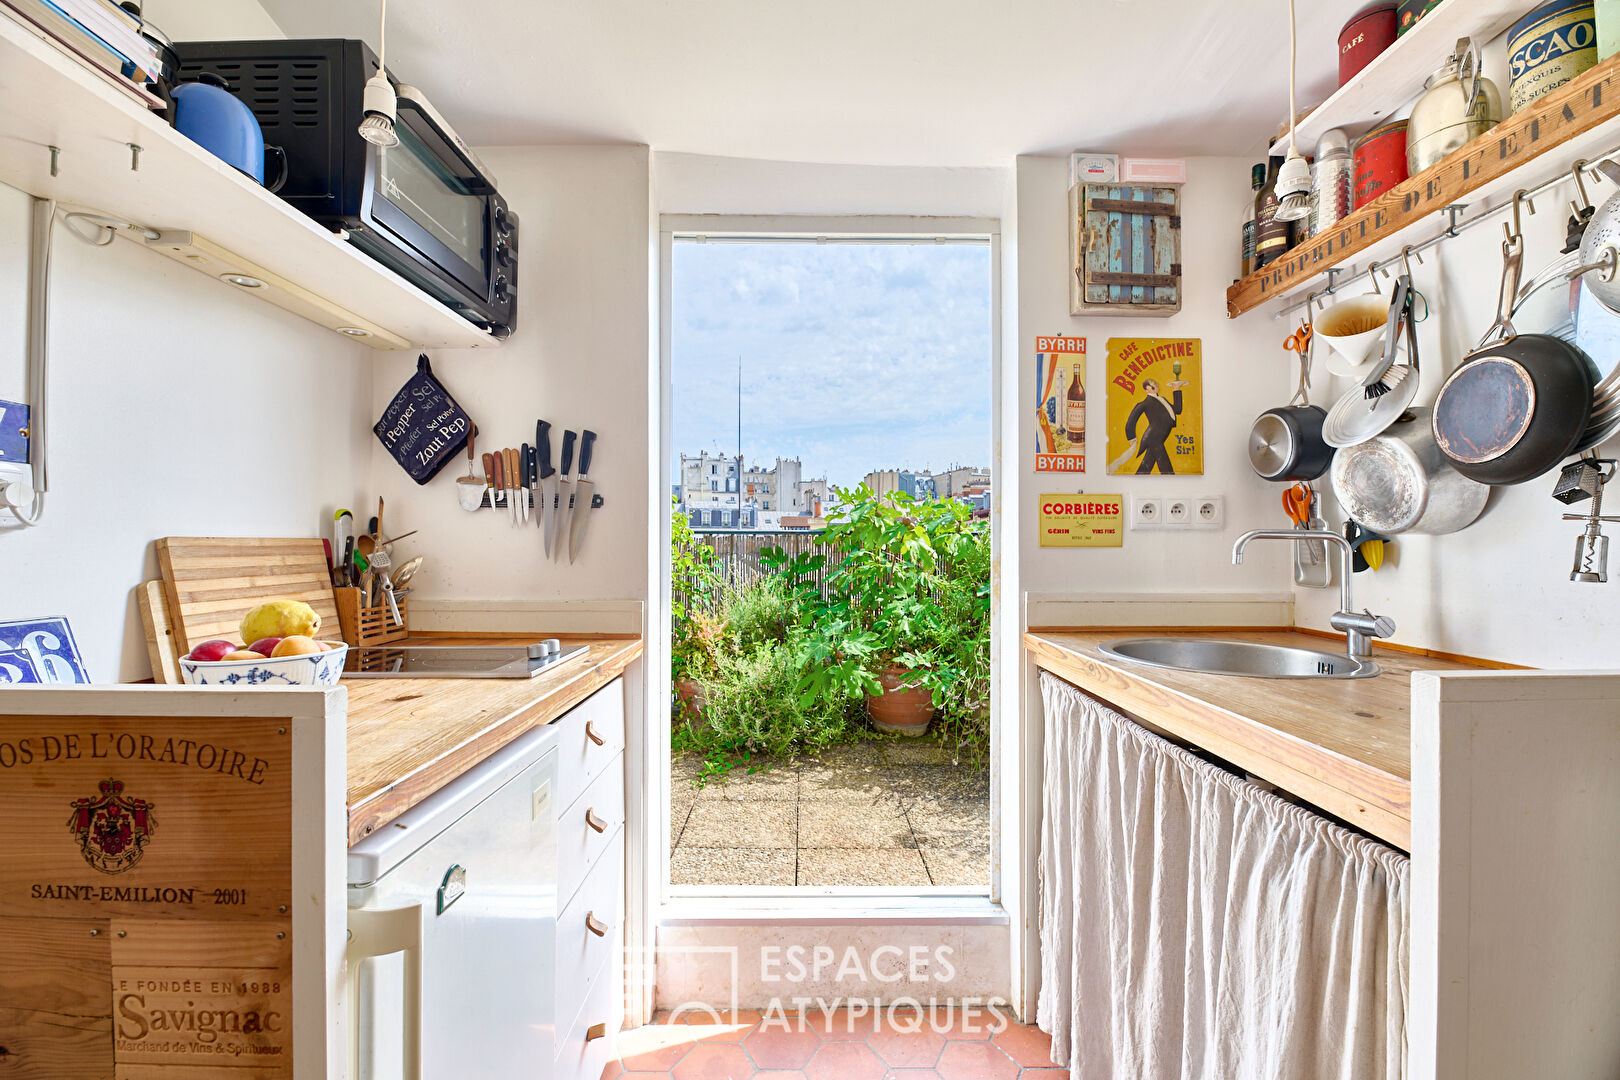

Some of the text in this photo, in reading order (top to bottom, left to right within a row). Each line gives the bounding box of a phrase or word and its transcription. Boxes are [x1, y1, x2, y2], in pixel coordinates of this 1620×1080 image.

[1342, 32, 1365, 54] CAFÉ
[1261, 208, 1388, 293] PROPRIETE
[1404, 176, 1442, 212] DE
[1038, 338, 1085, 352] BYRRH
[1119, 342, 1138, 361] CAFE
[1113, 342, 1194, 395] BENEDICTINE
[412, 380, 435, 402] Sel
[386, 403, 417, 443] Pepper
[426, 420, 439, 432] Sel
[416, 417, 465, 466] Zout Pep
[1175, 435, 1194, 444] Yes
[1176, 445, 1195, 455] Sir!
[1038, 456, 1084, 470] BYRRH
[1042, 502, 1120, 515] CORBIÈRES
[42, 734, 82, 762] DE
[91, 733, 269, 785] L'ORATOIRE
[31, 884, 246, 905] SAINT-EMILION 2001
[137, 979, 202, 993] FONDÉE
[211, 982, 232, 993] EN
[118, 993, 282, 1043] Savignac
[116, 1040, 283, 1056] Marchand de Vins & Spiritueux
